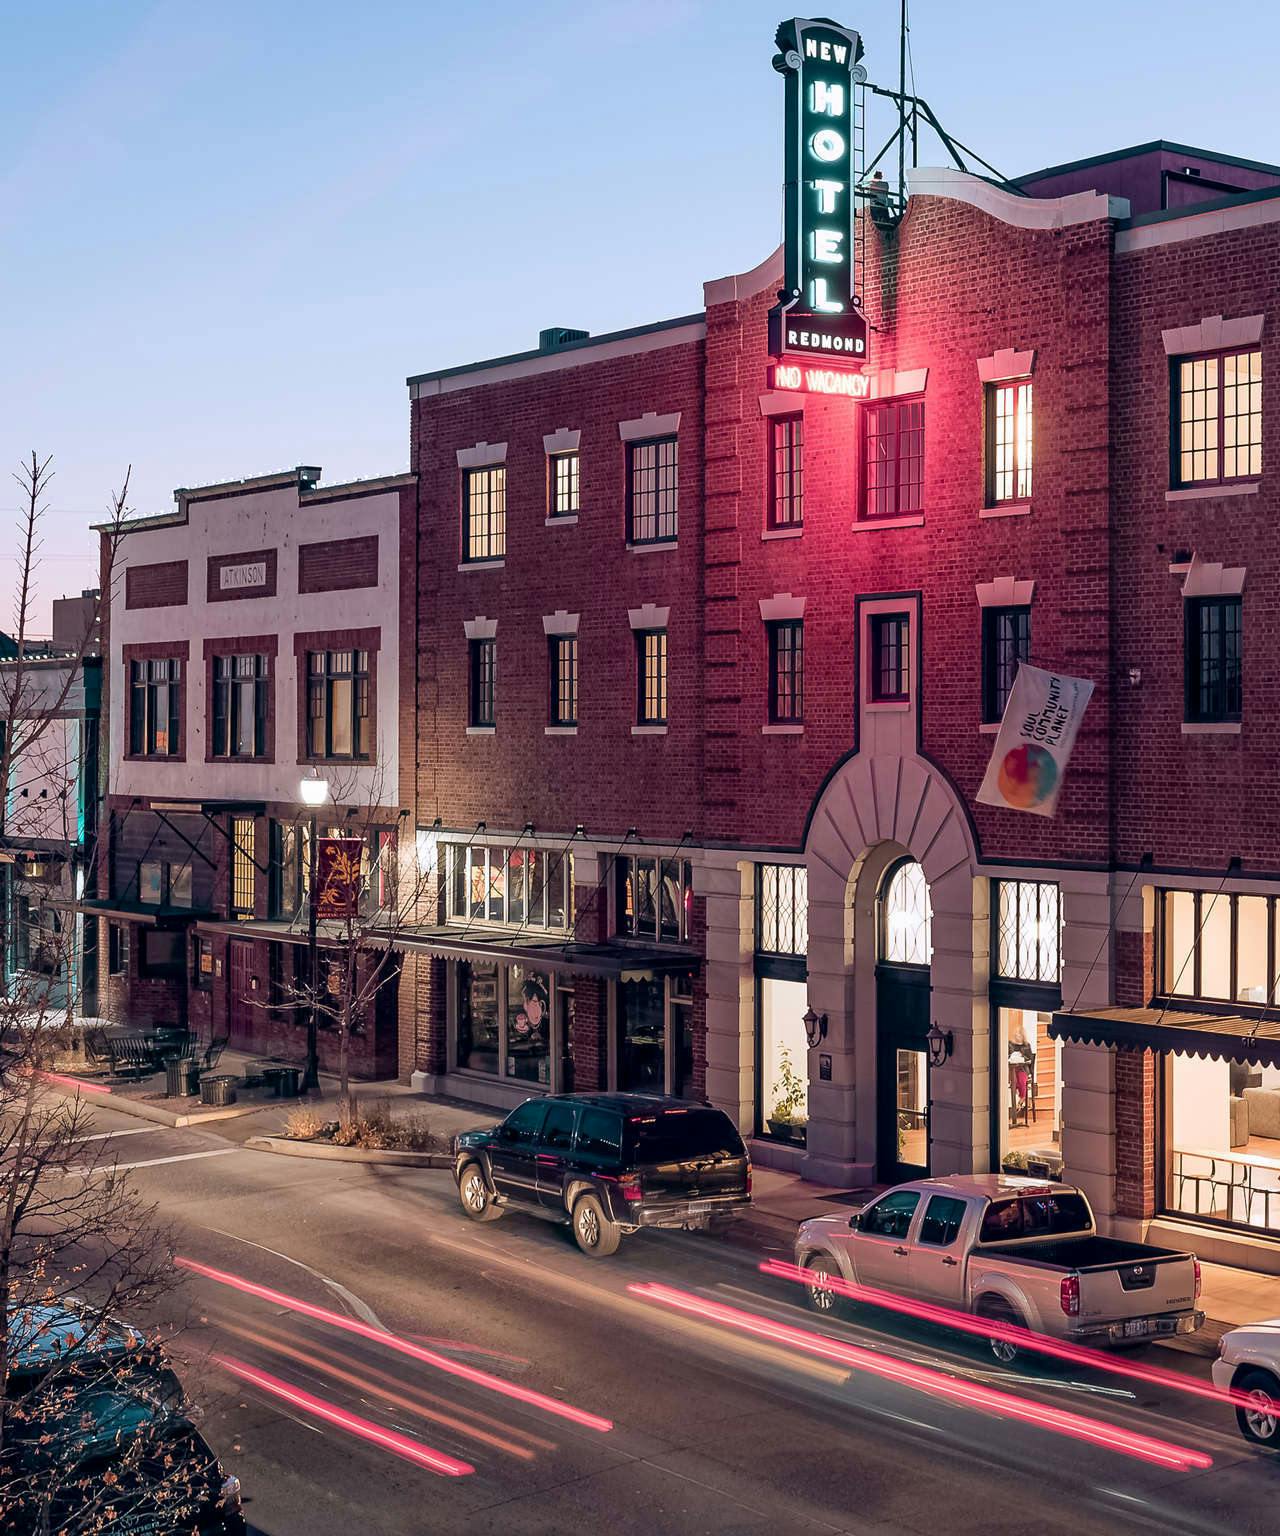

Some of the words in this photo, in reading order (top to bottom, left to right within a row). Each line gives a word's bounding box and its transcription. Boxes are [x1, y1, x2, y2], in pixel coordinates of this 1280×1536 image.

[806, 38, 847, 65] NEW
[809, 79, 844, 313] HOTEL
[788, 330, 865, 353] REDMOND
[776, 365, 802, 389] NO
[805, 369, 869, 397] VACANCY
[225, 567, 263, 586] ATKINSON
[1033, 677, 1061, 741] COMMUNITY
[1020, 711, 1041, 738] SOUL
[1045, 706, 1069, 746] PLANET
